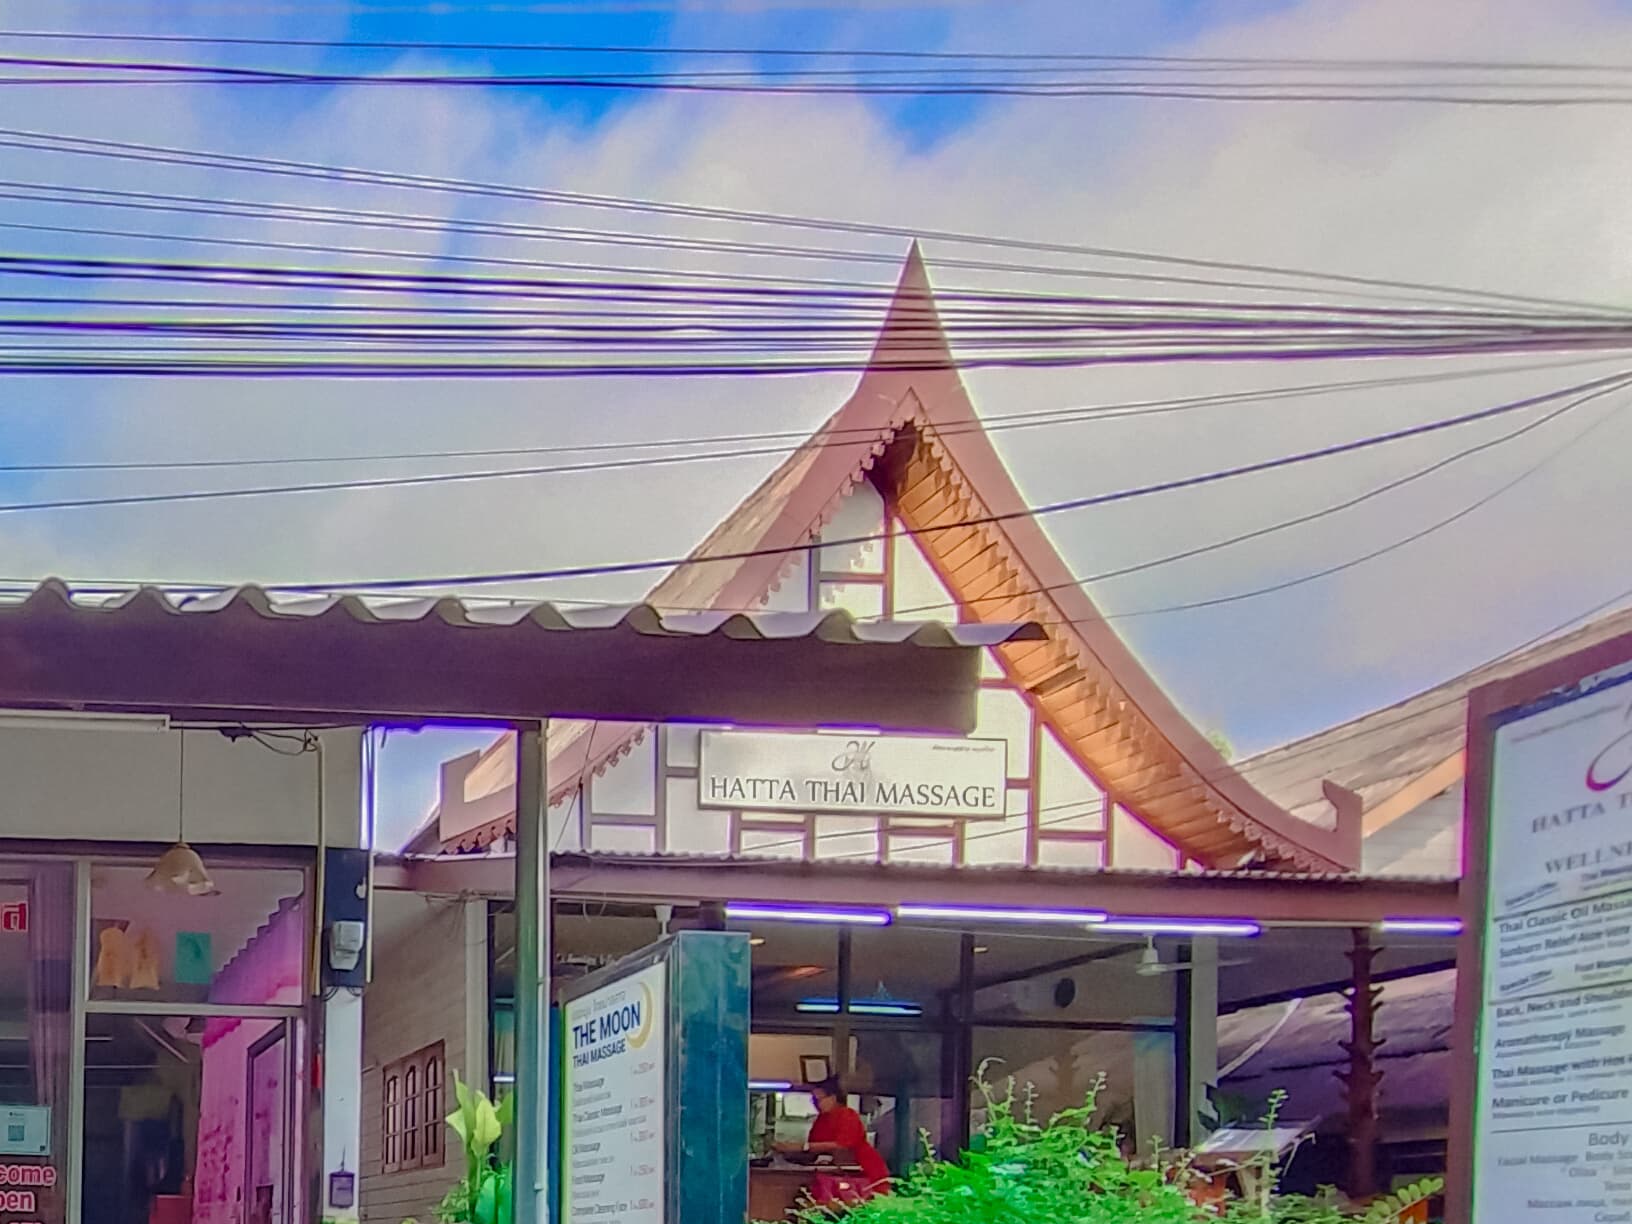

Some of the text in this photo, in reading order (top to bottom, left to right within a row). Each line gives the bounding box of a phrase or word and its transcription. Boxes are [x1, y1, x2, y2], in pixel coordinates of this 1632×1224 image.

[710, 777, 996, 808] HATTA THAI MASSAGE
[1532, 802, 1606, 834] HATTA
[572, 1018, 597, 1050] THE
[599, 1000, 641, 1041] MOON
[572, 1037, 627, 1070] THAI MASSAGE
[1588, 1130, 1630, 1147] Body
